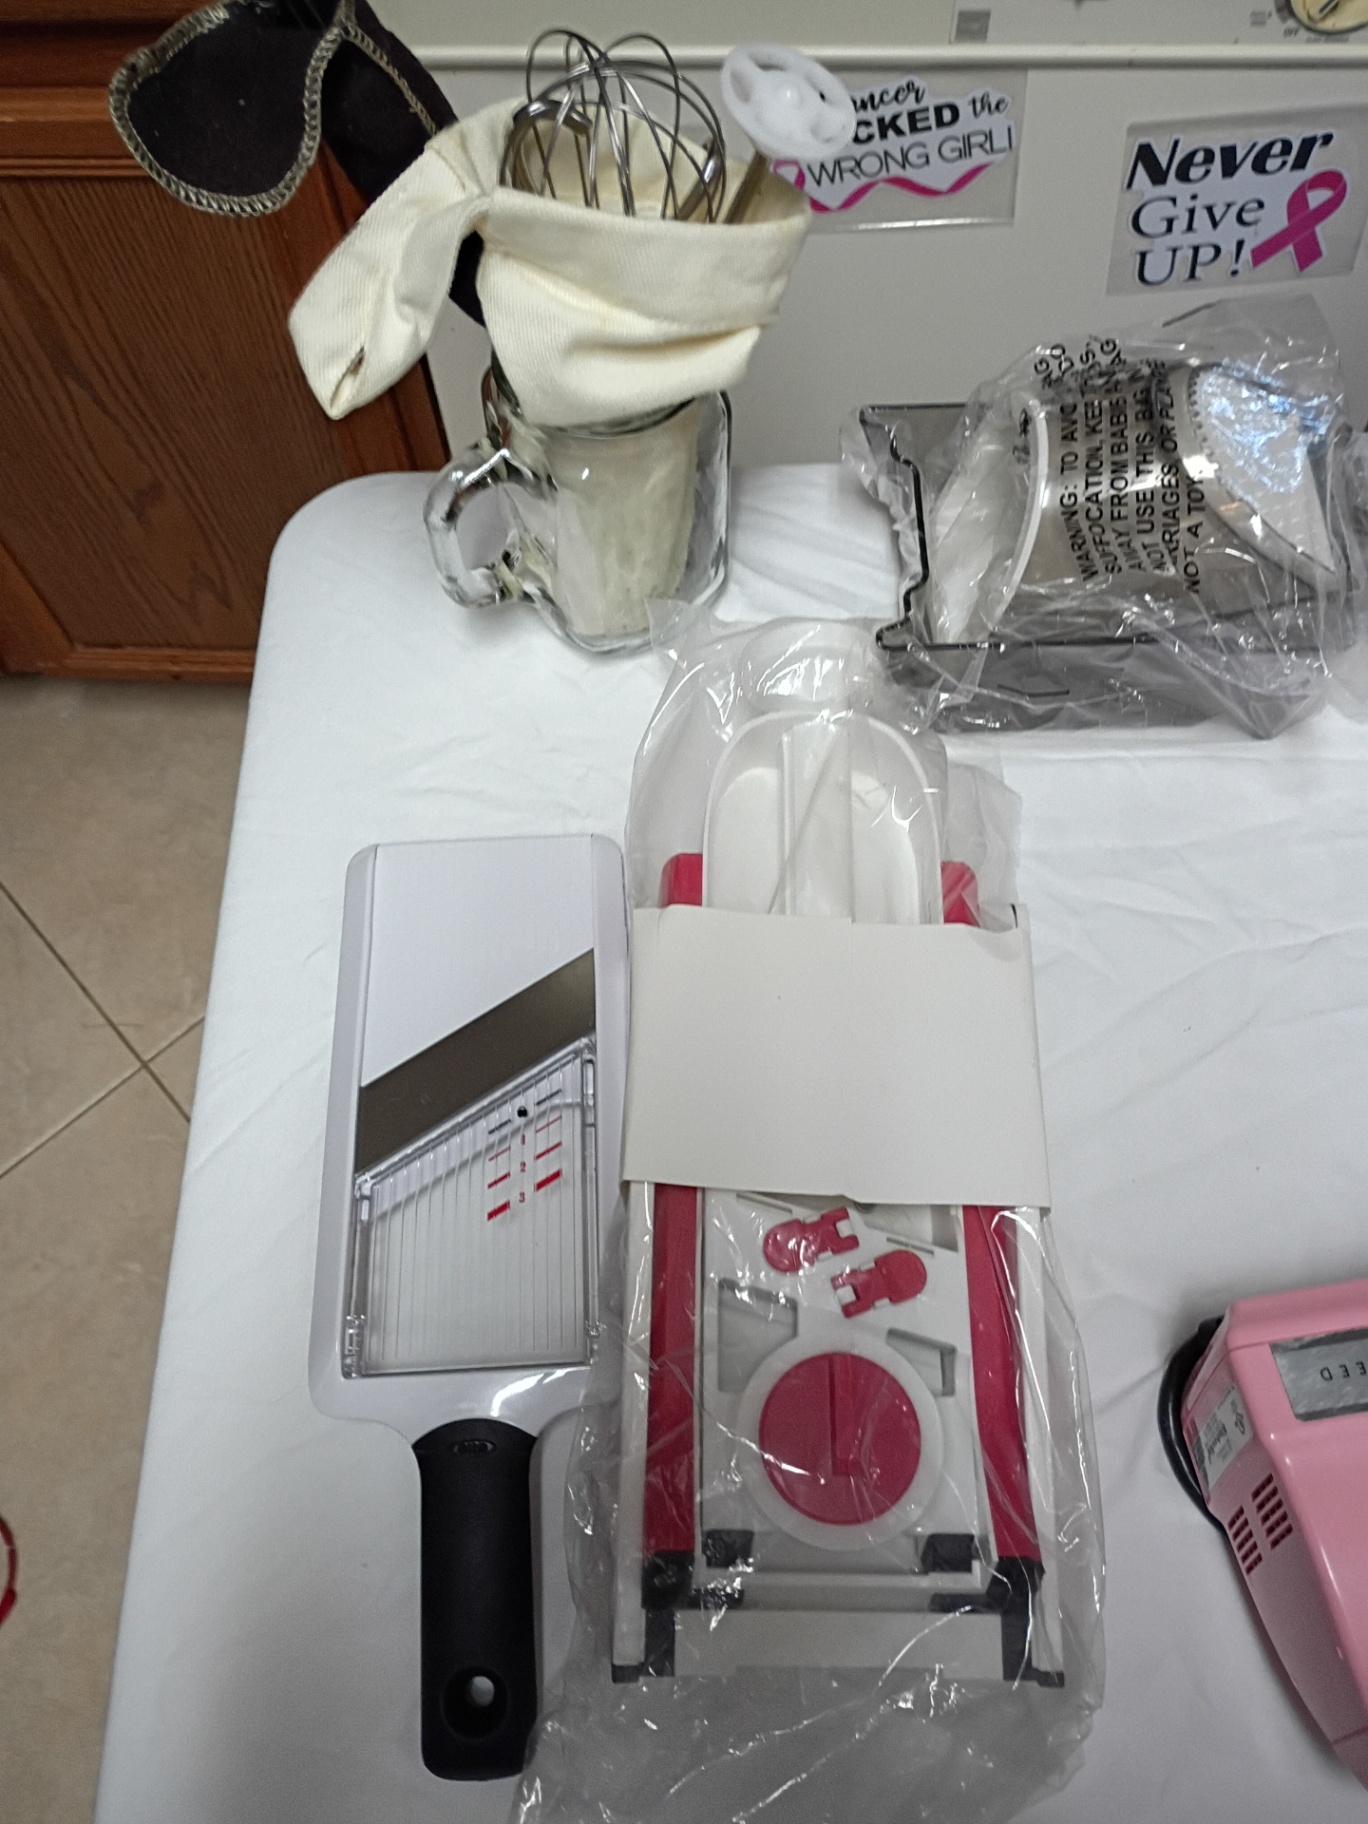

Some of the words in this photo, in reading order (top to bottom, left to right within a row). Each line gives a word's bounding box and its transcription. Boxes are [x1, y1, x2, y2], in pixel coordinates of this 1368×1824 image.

[968, 91, 1009, 118] the
[807, 141, 930, 188] WRONG
[1126, 131, 1334, 191] Never
[1131, 193, 1265, 240] Give
[1136, 238, 1246, 287] UP!
[1135, 431, 1154, 478] THIS
[1159, 424, 1178, 453] OR
[1060, 451, 1078, 476] TO
[1110, 458, 1129, 522] FROM
[1136, 489, 1155, 535] USE
[1059, 484, 1099, 582] WARNING:
[1112, 528, 1147, 572] AWAY
[1186, 521, 1204, 540] A
[1142, 541, 1167, 571] NOT
[1183, 546, 1201, 595] NOT
[520, 1161, 527, 1173] 2
[519, 1191, 526, 1203] 3
